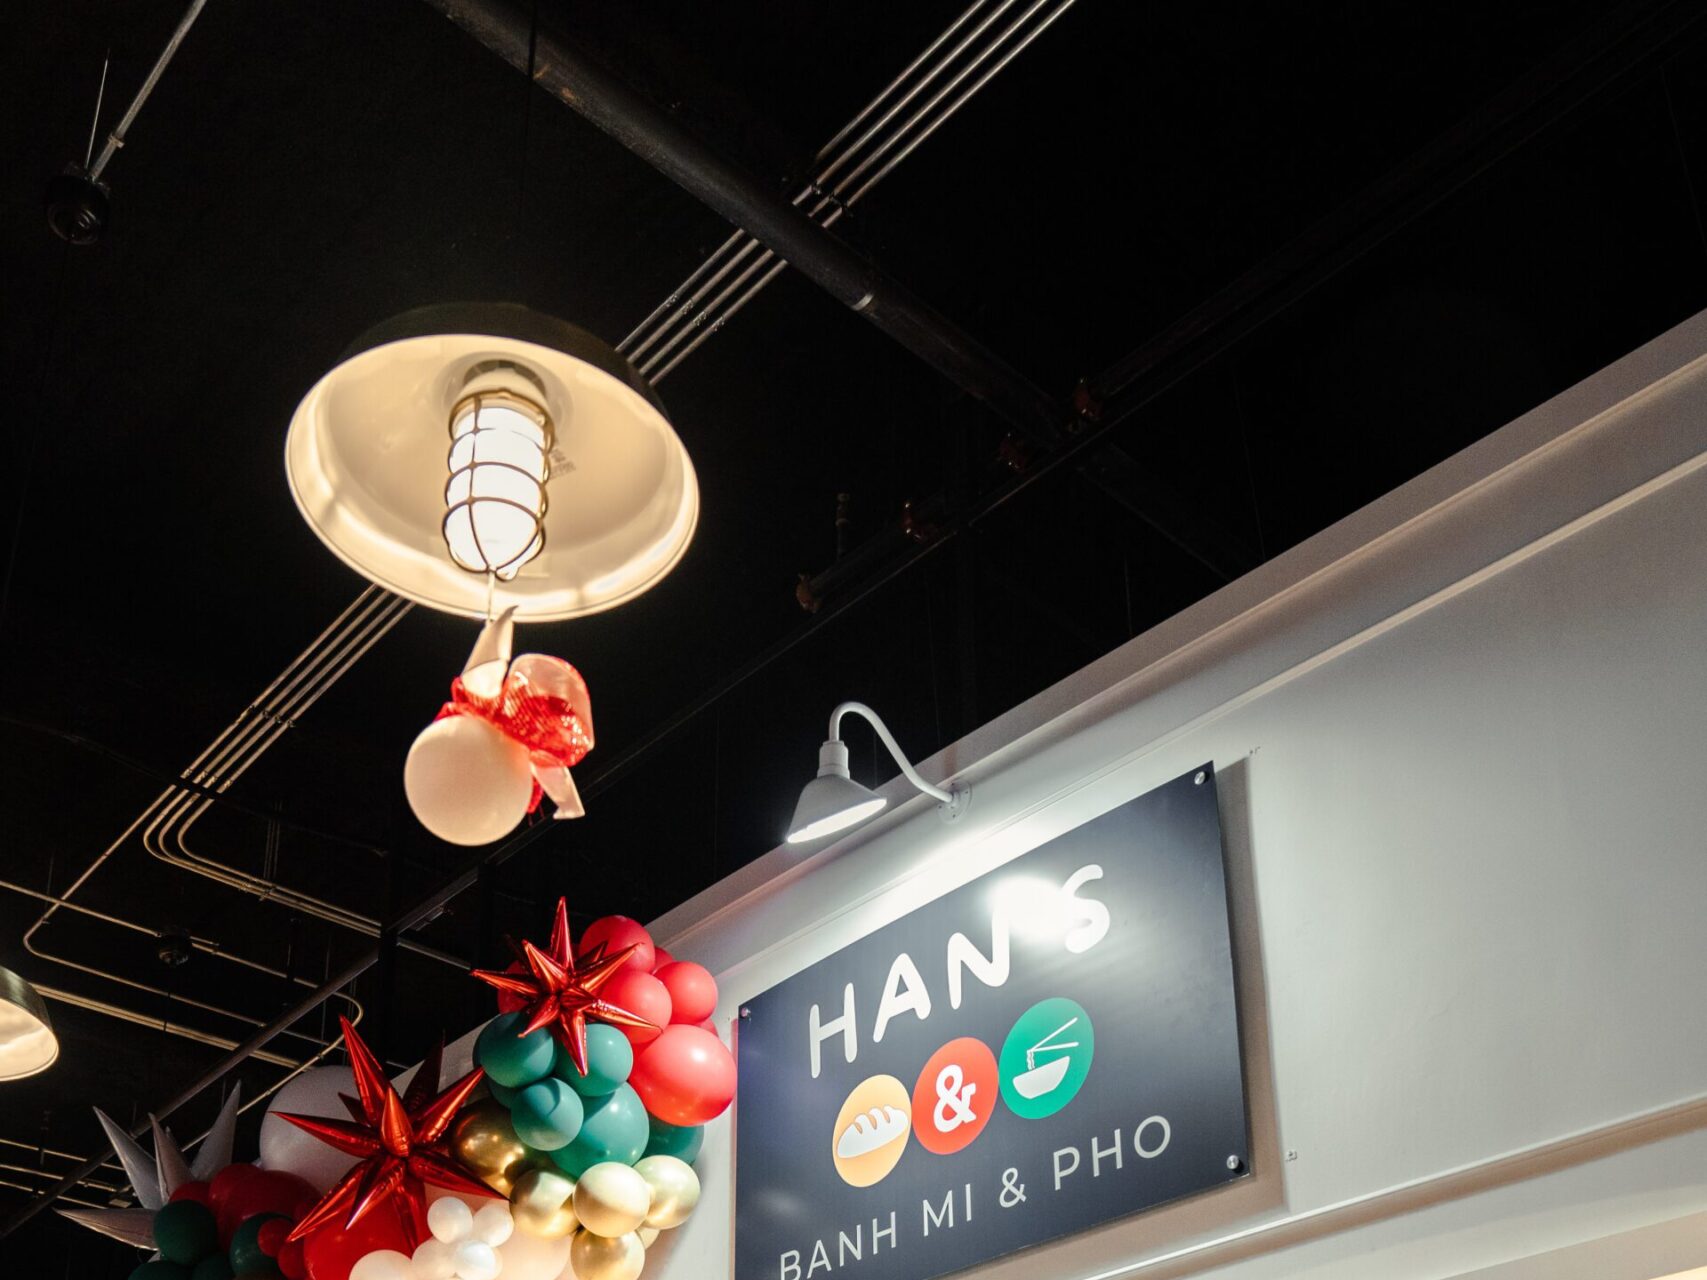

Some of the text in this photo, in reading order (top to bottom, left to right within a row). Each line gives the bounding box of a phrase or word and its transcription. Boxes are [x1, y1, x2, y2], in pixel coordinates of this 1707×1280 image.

[809, 864, 1111, 1078] HANS
[932, 1064, 977, 1132] &
[922, 1183, 973, 1237] MI
[998, 1167, 1027, 1208] &
[1054, 1115, 1171, 1190] PHO
